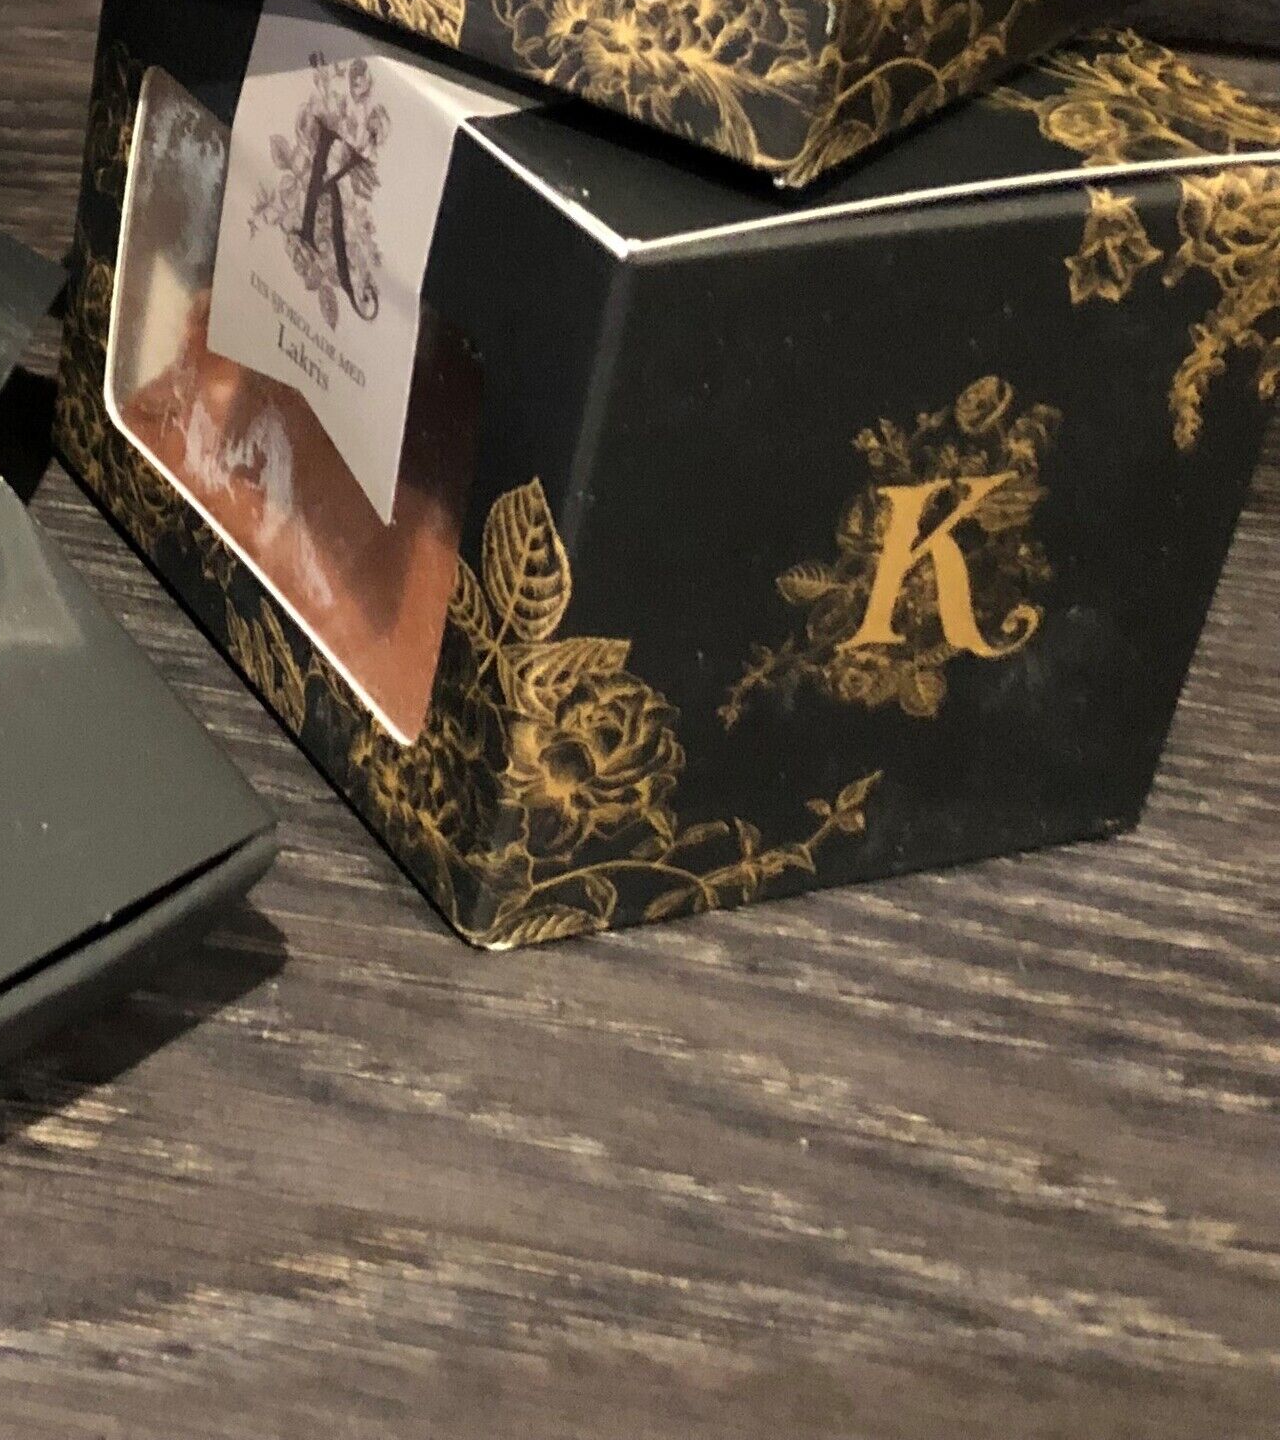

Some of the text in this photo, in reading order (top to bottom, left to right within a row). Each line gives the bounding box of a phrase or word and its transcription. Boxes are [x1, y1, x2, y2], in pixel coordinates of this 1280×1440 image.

[290, 114, 382, 323] K
[277, 320, 329, 391] Lakris
[834, 469, 1042, 659] K
